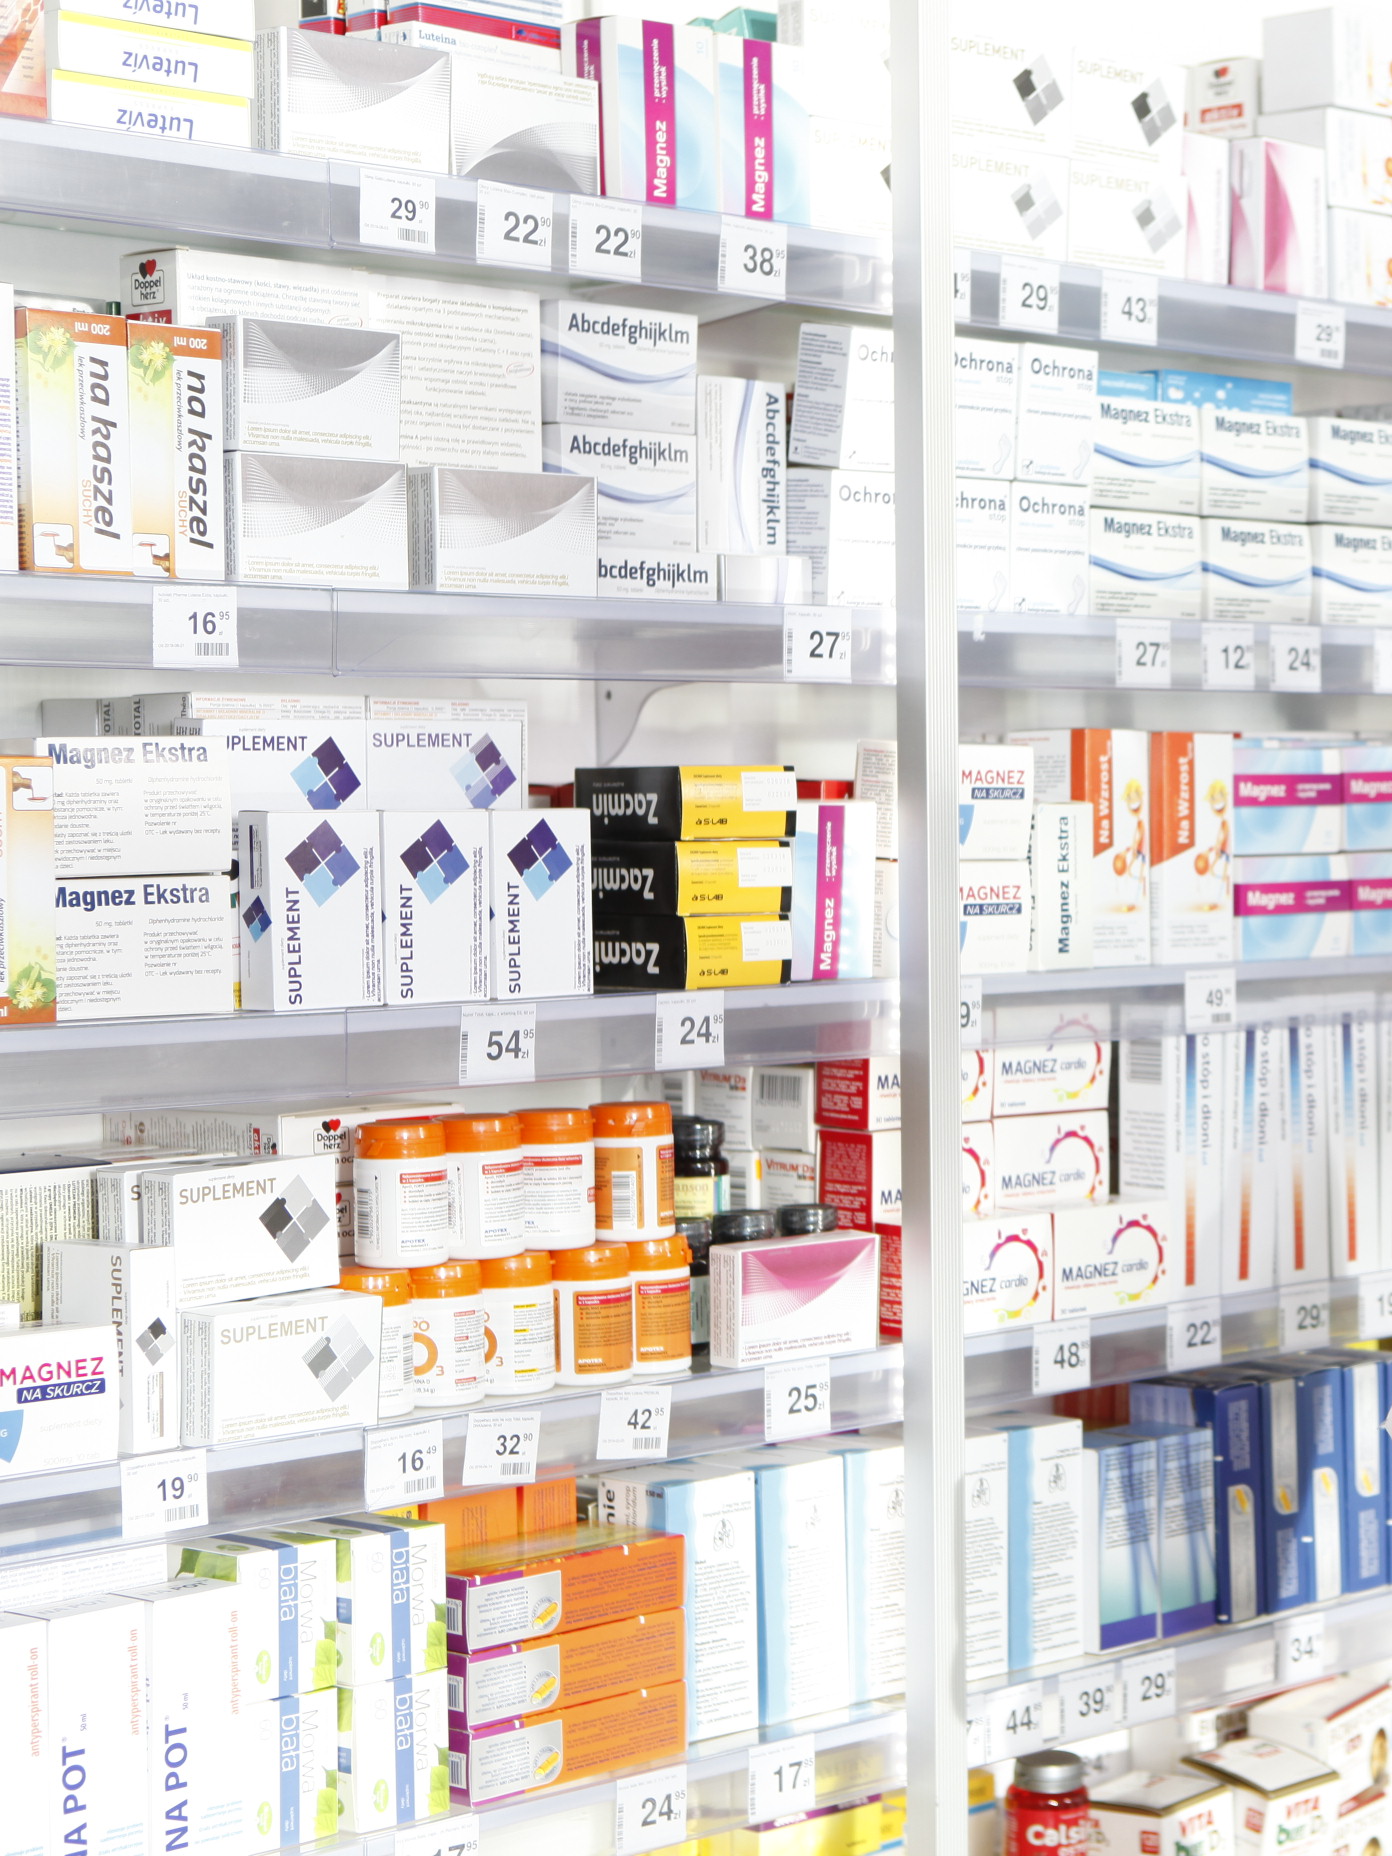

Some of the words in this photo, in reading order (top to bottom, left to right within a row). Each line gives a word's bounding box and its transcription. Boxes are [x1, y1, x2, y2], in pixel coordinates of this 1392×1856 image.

[418, 30, 456, 46] Luteina
[951, 37, 1025, 62] SUPLEMENT
[1077, 59, 1144, 85] SUPLEMENT
[653, 120, 667, 198] Magnez
[952, 154, 1029, 178] SUPLEMENT
[752, 136, 765, 212] Magnez
[1072, 171, 1150, 194] SUPLEMENT
[391, 197, 417, 221] 29
[503, 211, 539, 245] 22
[595, 225, 629, 257] 22
[743, 244, 774, 276] 38
[134, 277, 161, 292] Doppel
[140, 288, 157, 301] herz
[1021, 282, 1048, 311] 29
[1122, 296, 1147, 323] 43
[75, 322, 88, 332] ml
[90, 324, 110, 336] 200
[568, 312, 691, 347] Abcdefghijklm
[174, 335, 186, 347] ml
[188, 338, 207, 349] 200
[89, 356, 109, 407] na
[1030, 357, 1094, 382] Ochrona
[186, 370, 207, 419] na
[1100, 402, 1150, 424] Magnez
[1154, 408, 1192, 428] Ekstra
[1215, 415, 1262, 436] Magnez
[1264, 421, 1301, 439] Ekstra
[1331, 425, 1375, 445] Magnez
[569, 435, 689, 467] Abcdefghijklm
[91, 420, 121, 540] kaszel
[761, 392, 781, 546] Abcdefghijklm
[83, 479, 92, 527] SUCHY
[188, 433, 214, 549] kaszel
[179, 491, 188, 538] SUCHY
[1019, 496, 1085, 517] Ochrona
[1103, 516, 1153, 537] Magnez
[1156, 521, 1194, 540] Ekstra
[1221, 526, 1266, 547] Magnez
[1268, 530, 1304, 547] Ekstra
[1334, 533, 1378, 552] Magnez
[188, 611, 216, 635] 16
[219, 611, 230, 621] 95
[809, 631, 840, 660] 27
[1135, 642, 1161, 668] 27
[1221, 645, 1245, 670] 12
[1288, 648, 1311, 672] 24
[372, 732, 472, 749] SUPLEMENT
[48, 743, 135, 769] Magnez
[142, 742, 209, 764] Ekstra
[961, 770, 1025, 785] MAGNEZ
[1239, 781, 1286, 801] Magnez
[974, 789, 987, 799] NA
[988, 788, 1023, 799] SKURCZ
[592, 791, 658, 826] Zacmin
[1058, 815, 1069, 874] Ekstra
[1099, 823, 1110, 844] Na
[1178, 823, 1190, 844] Na
[143, 884, 210, 905] Ekstra
[1247, 890, 1295, 909] Magnez
[967, 904, 979, 915] NA
[981, 904, 1020, 915] SKURCZ
[1058, 879, 1072, 954] Magnez
[285, 887, 303, 1005] SUPLEMENT
[400, 884, 414, 999] SUPLEMENT
[508, 882, 521, 993] SUPLEMENT
[820, 898, 835, 971] Magnez
[1206, 989, 1224, 1007] 49
[680, 1016, 713, 1045] 24
[713, 1014, 724, 1025] 95
[486, 1030, 521, 1061] 54
[523, 1029, 534, 1040] 95
[1001, 1059, 1057, 1076] MAGNEZ
[1060, 1059, 1086, 1072] cardio
[316, 1131, 347, 1144] Doppel
[323, 1140, 341, 1150] herz
[179, 1178, 277, 1206] SUPLEMENT
[1001, 1170, 1056, 1190] MAGNEZ
[1059, 1170, 1085, 1183] cardio
[1000, 1275, 1028, 1291] cardio
[1061, 1261, 1119, 1282] MAGNEZ
[1122, 1259, 1148, 1273] cardio
[110, 1254, 124, 1377] SUPLEMENT
[1297, 1306, 1320, 1330] 29
[220, 1316, 328, 1345] SUPLEMENT
[1186, 1322, 1211, 1347] 22
[1053, 1343, 1081, 1370] 48
[0, 1356, 104, 1386] MAGNEZ
[21, 1386, 42, 1402] NA
[44, 1379, 101, 1399] SKURCZ
[787, 1384, 818, 1415] 25
[627, 1408, 652, 1431] 42
[495, 1434, 521, 1456] 32
[397, 1448, 424, 1474] 16
[156, 1476, 185, 1501] 19
[186, 1473, 199, 1484] 90
[392, 1547, 408, 1605] biała
[411, 1544, 427, 1627] Morwa
[280, 1564, 297, 1622] biała
[301, 1559, 317, 1644] Morwa
[1291, 1639, 1315, 1662] 34
[231, 1645, 240, 1715] antyperspirant
[1140, 1673, 1165, 1701] 29
[130, 1664, 139, 1736] antyperspirant
[1078, 1691, 1104, 1717] 39
[30, 1682, 40, 1757] antyperspirant
[396, 1693, 412, 1751] biała
[415, 1688, 430, 1772] Morwa
[1006, 1709, 1033, 1734] 44
[281, 1714, 298, 1773] biała
[302, 1709, 319, 1795] Morwa
[164, 1724, 188, 1792] POT
[61, 1744, 87, 1816] POT
[773, 1762, 802, 1793] 17
[641, 1794, 673, 1827] 24
[674, 1790, 686, 1801] 95
[165, 1799, 189, 1852] NA
